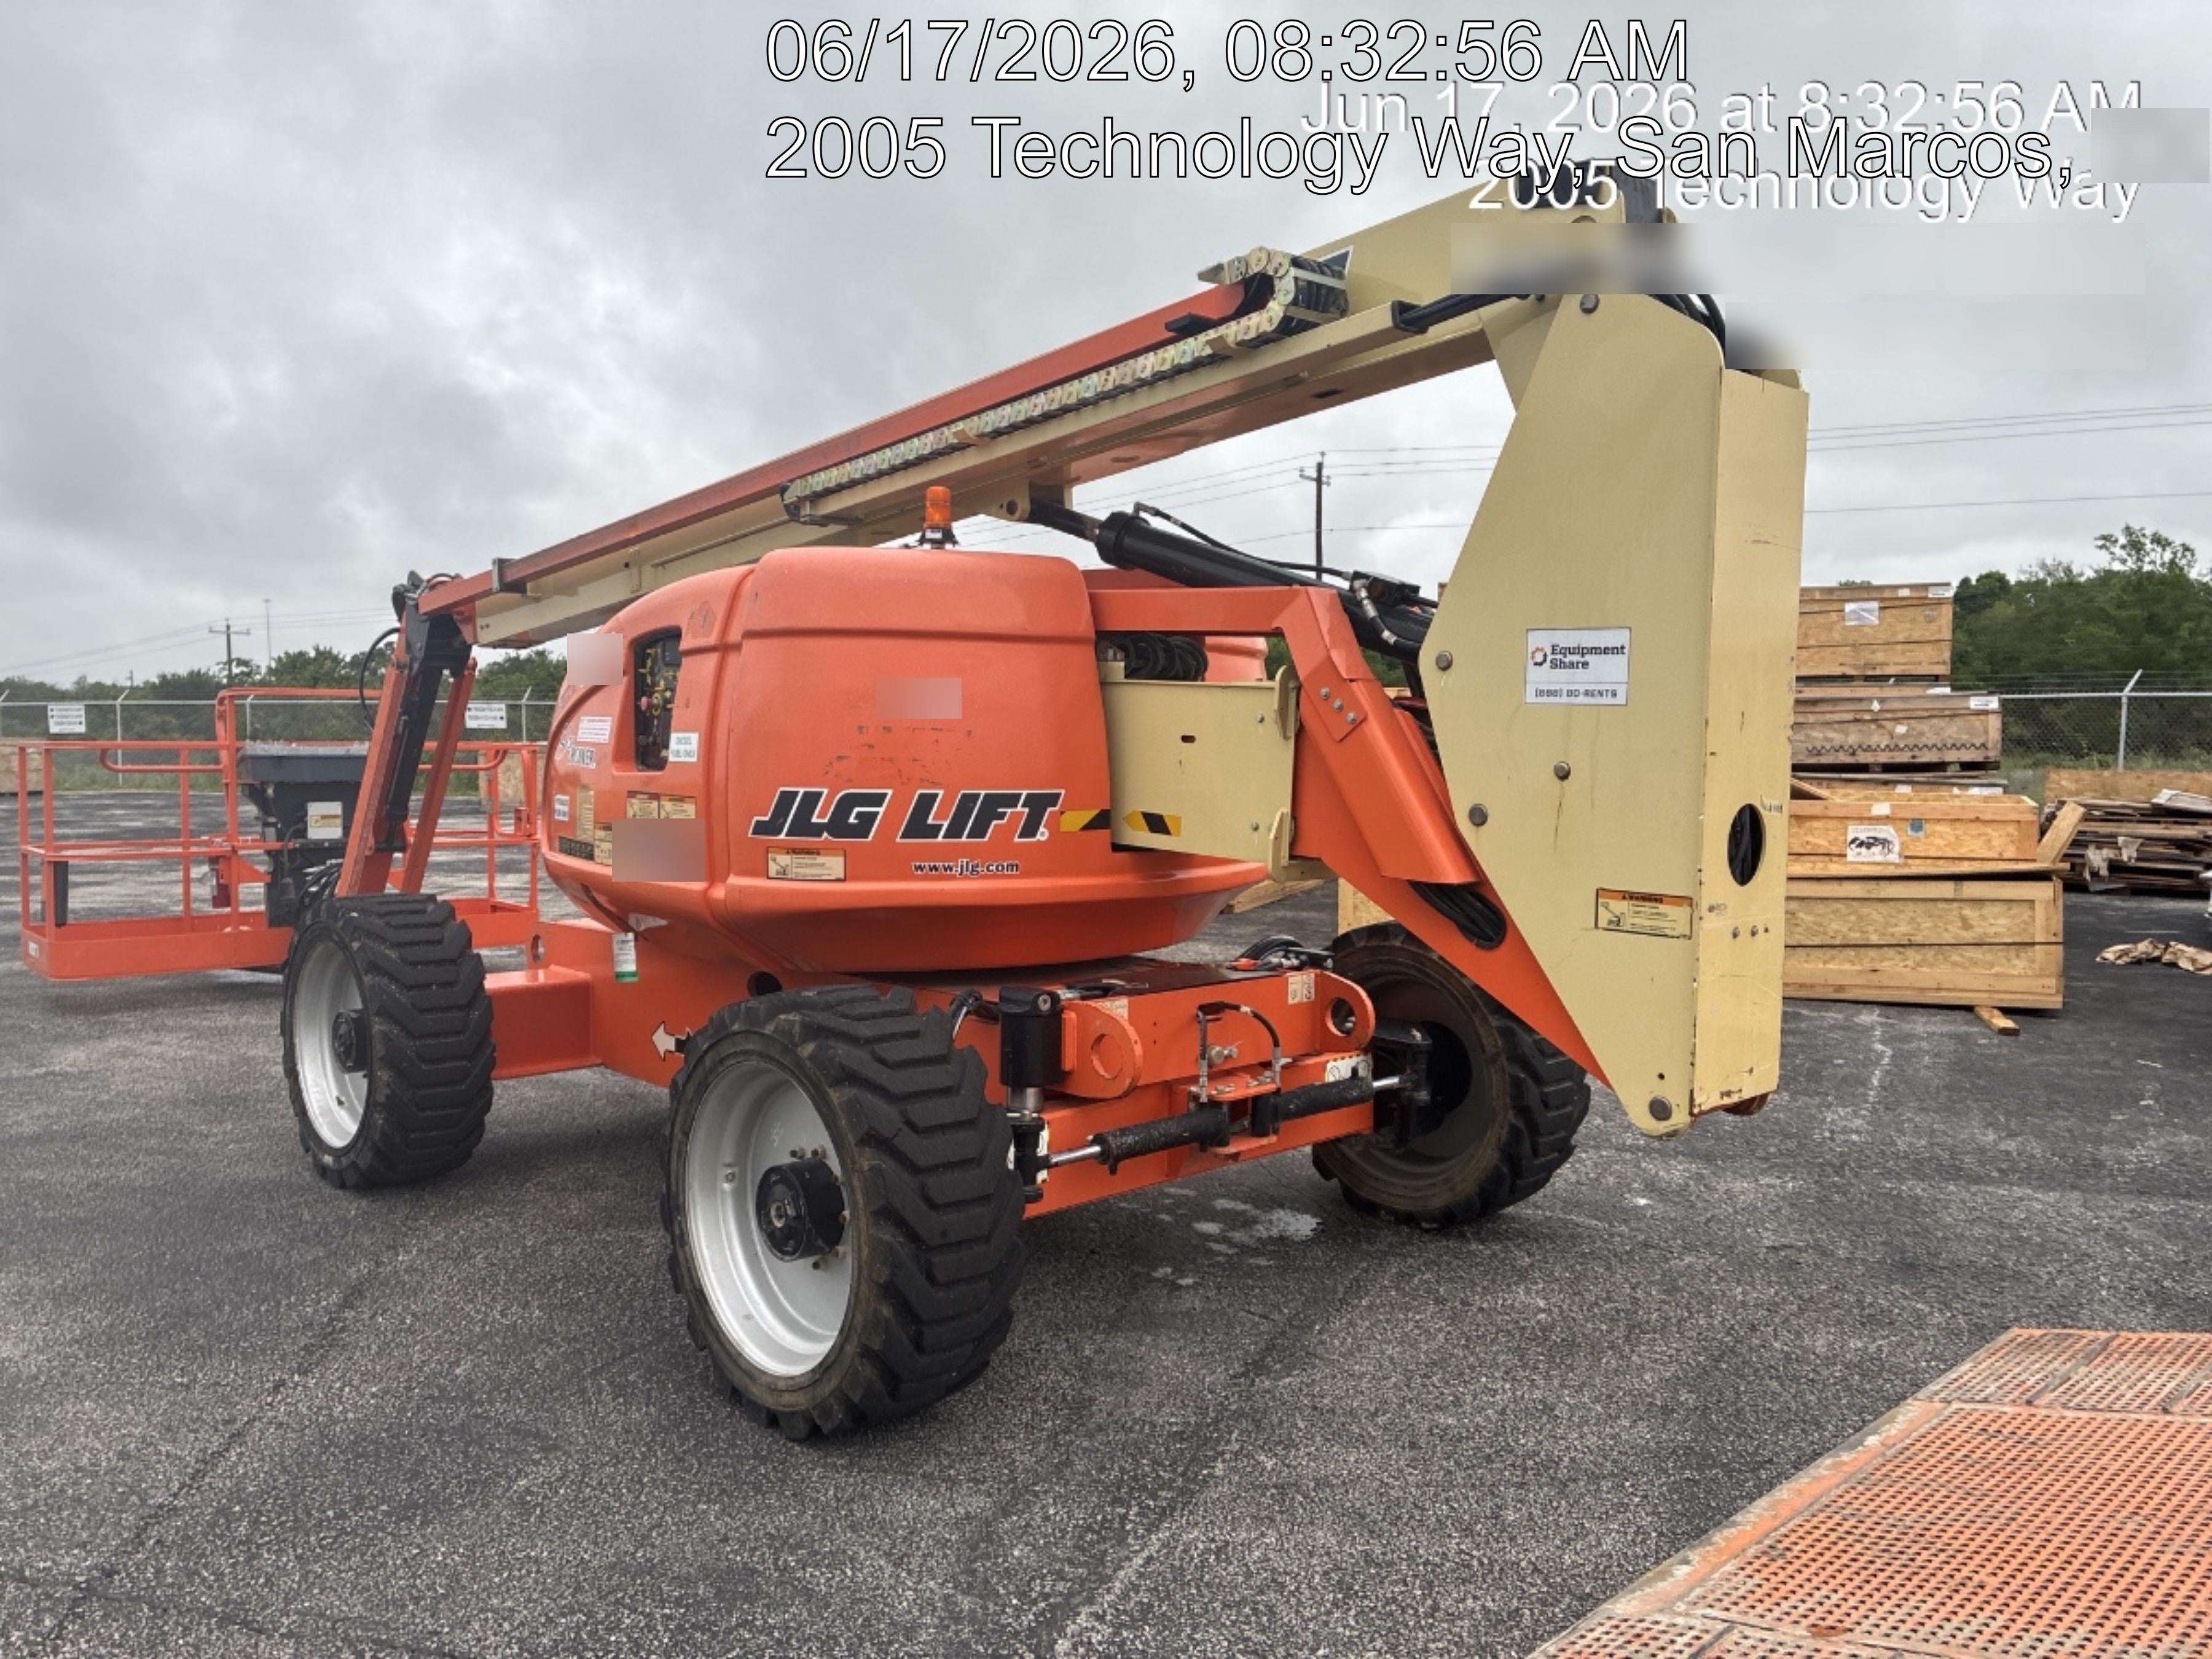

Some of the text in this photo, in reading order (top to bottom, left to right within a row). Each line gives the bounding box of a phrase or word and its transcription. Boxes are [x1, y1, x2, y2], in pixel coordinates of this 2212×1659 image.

[1550, 643, 1626, 658] Equipment
[1550, 658, 1590, 670] Share
[749, 788, 1065, 842] JLG LIFT
[912, 860, 1021, 878] www.jlg.com
